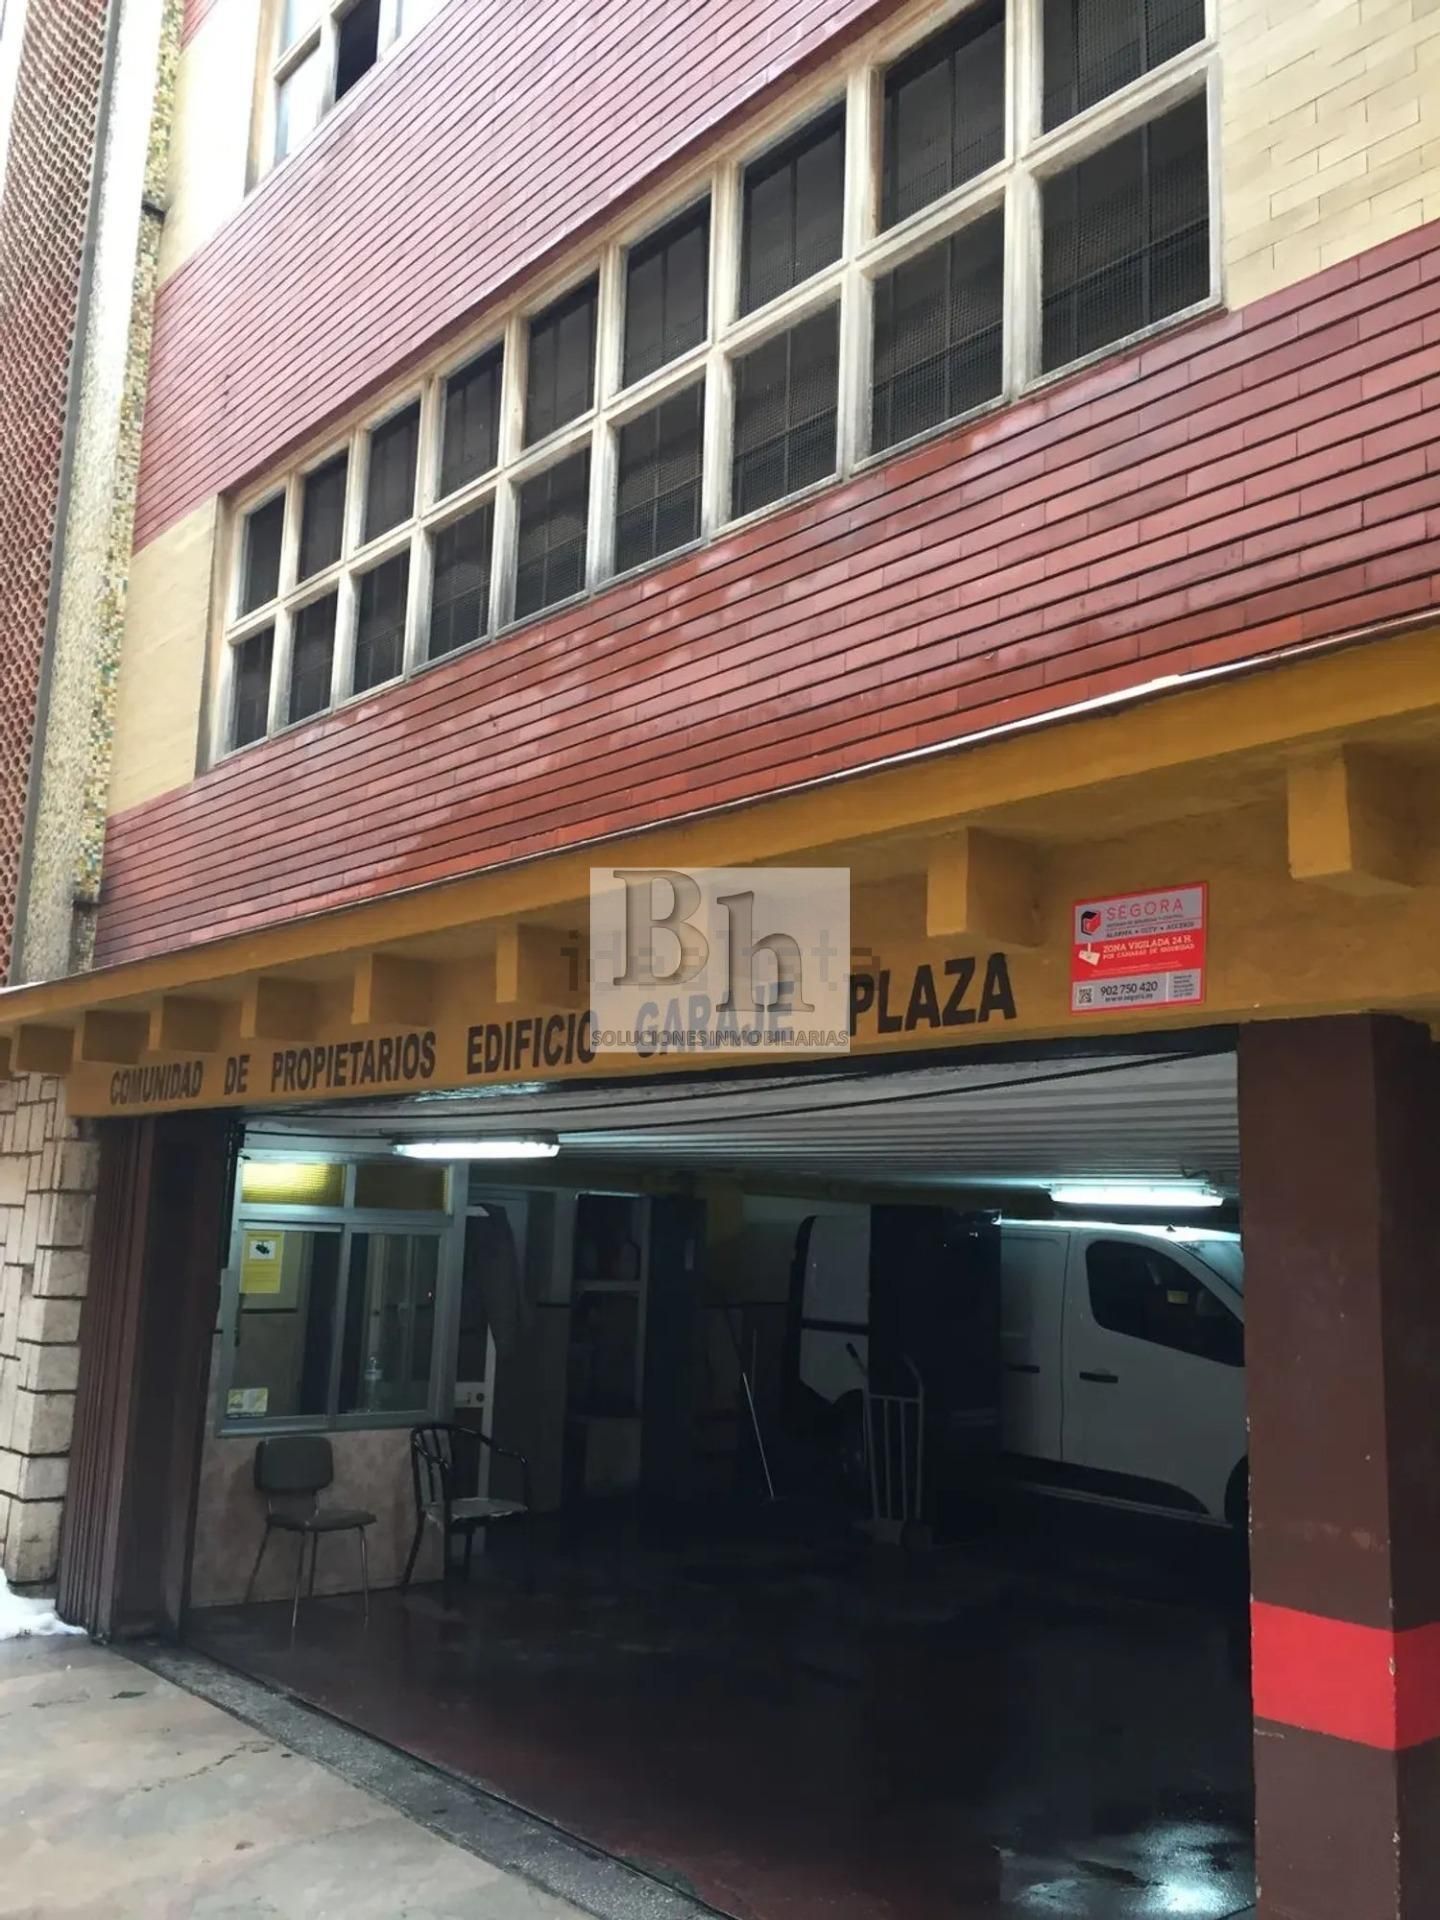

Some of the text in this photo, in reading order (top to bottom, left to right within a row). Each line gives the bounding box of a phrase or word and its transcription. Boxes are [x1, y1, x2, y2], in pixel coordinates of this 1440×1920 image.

[1107, 899, 1184, 921] SEGORA
[1103, 943, 1127, 953] ZONA
[1128, 937, 1170, 950] VIGILADA
[1100, 984, 1118, 996] 902
[1121, 982, 1138, 994] 750
[1139, 980, 1159, 992] 420
[110, 952, 1017, 1105] COMUNIDAD DE PROPIETARIOS EDIFICIO GARAJE PLAZA
